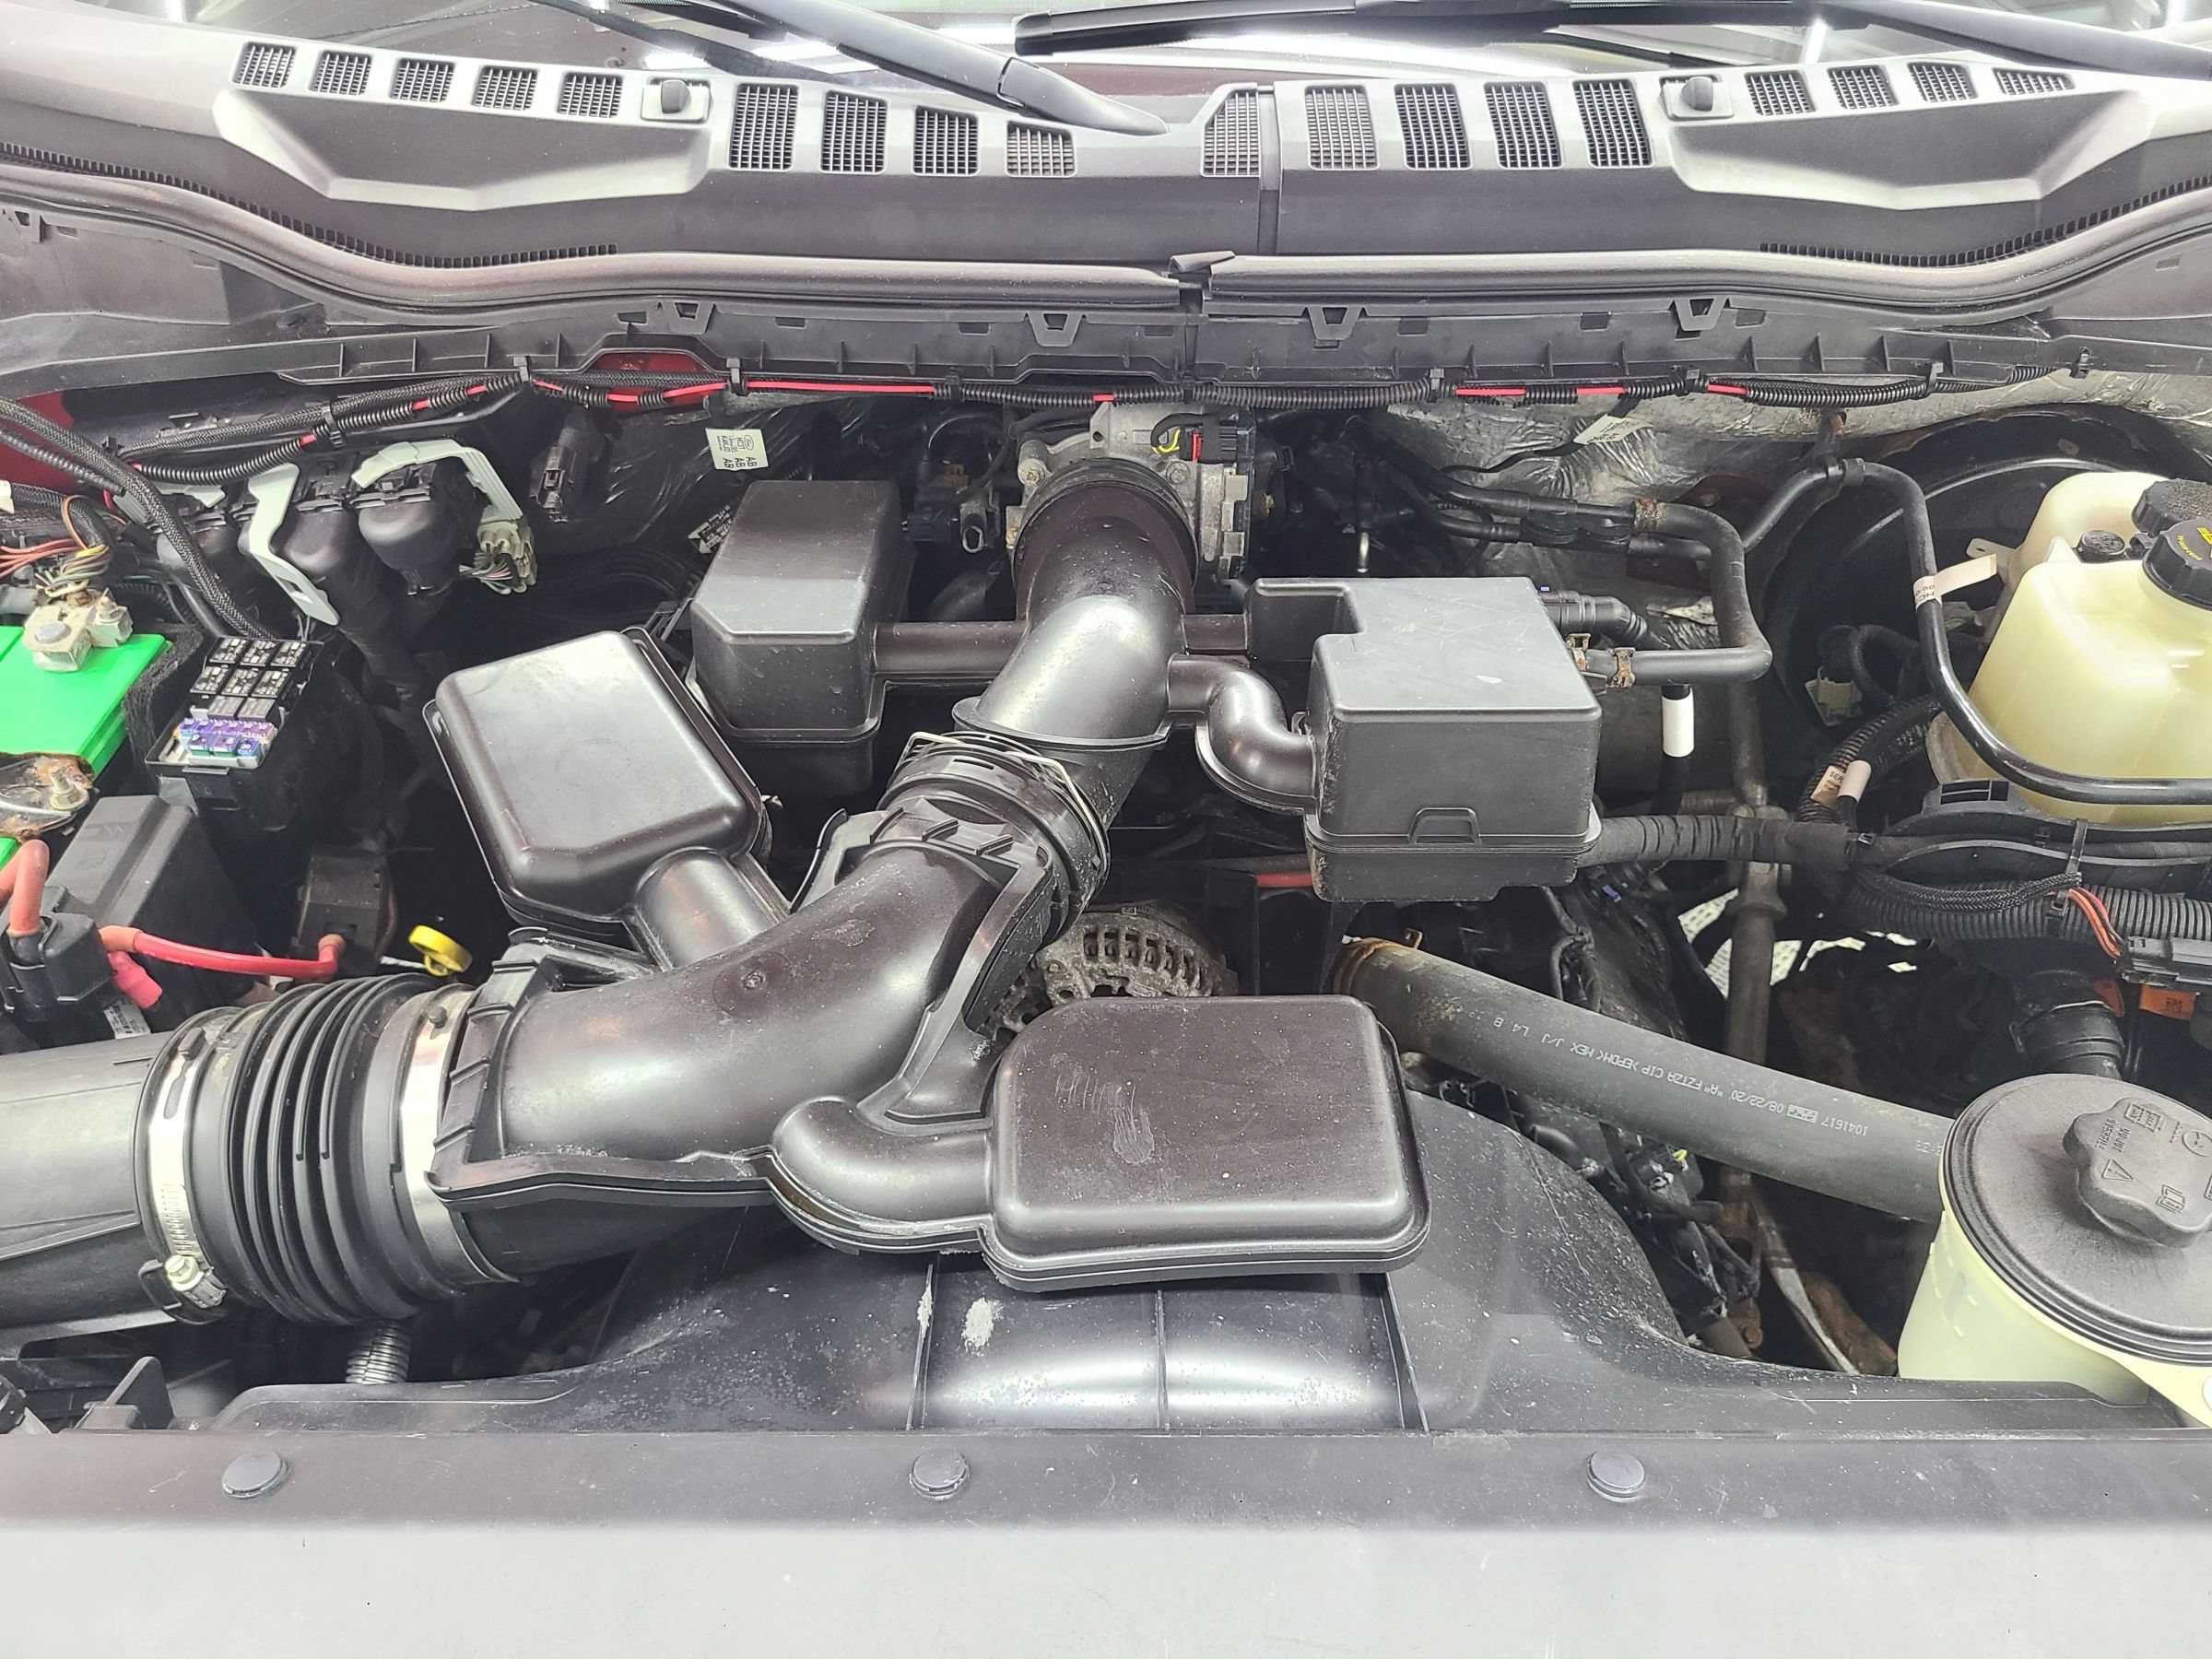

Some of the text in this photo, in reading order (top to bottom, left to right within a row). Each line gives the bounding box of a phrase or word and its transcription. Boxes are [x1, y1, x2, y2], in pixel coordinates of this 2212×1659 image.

[723, 457, 735, 468] AB
[734, 457, 746, 468] AB
[747, 456, 757, 467] AB
[1570, 1041, 1594, 1058] MEX
[1641, 1064, 1665, 1078] CIP
[1820, 1116, 1868, 1136] 1041617
